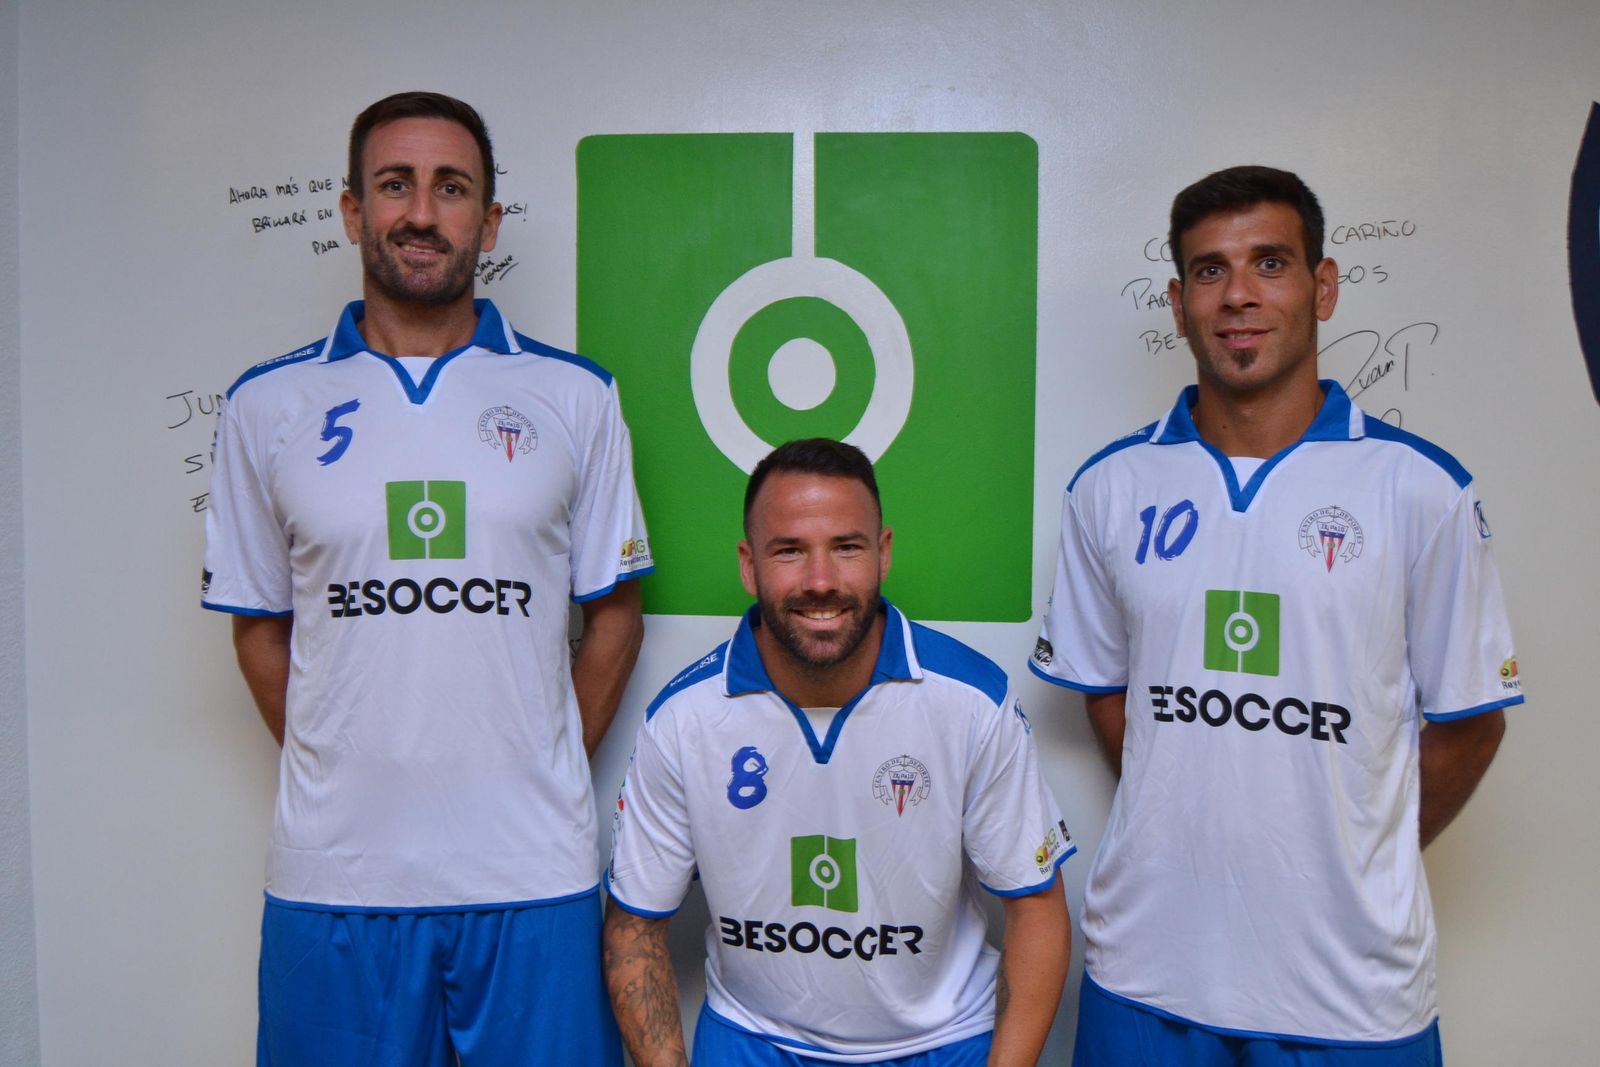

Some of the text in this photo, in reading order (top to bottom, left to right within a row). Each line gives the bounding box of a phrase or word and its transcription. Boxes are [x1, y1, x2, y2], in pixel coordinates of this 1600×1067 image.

[229, 186, 268, 204] AHORA
[308, 178, 333, 193] QUE
[317, 208, 333, 221] EN
[1331, 219, 1416, 245] CARIÑO
[312, 240, 340, 256] PARA
[1121, 277, 1171, 310] PAR
[316, 398, 361, 466] 5
[1135, 499, 1199, 565] 10
[327, 577, 532, 618] BESOCCER
[727, 746, 769, 810] 8
[719, 916, 924, 961] BESOCCER
